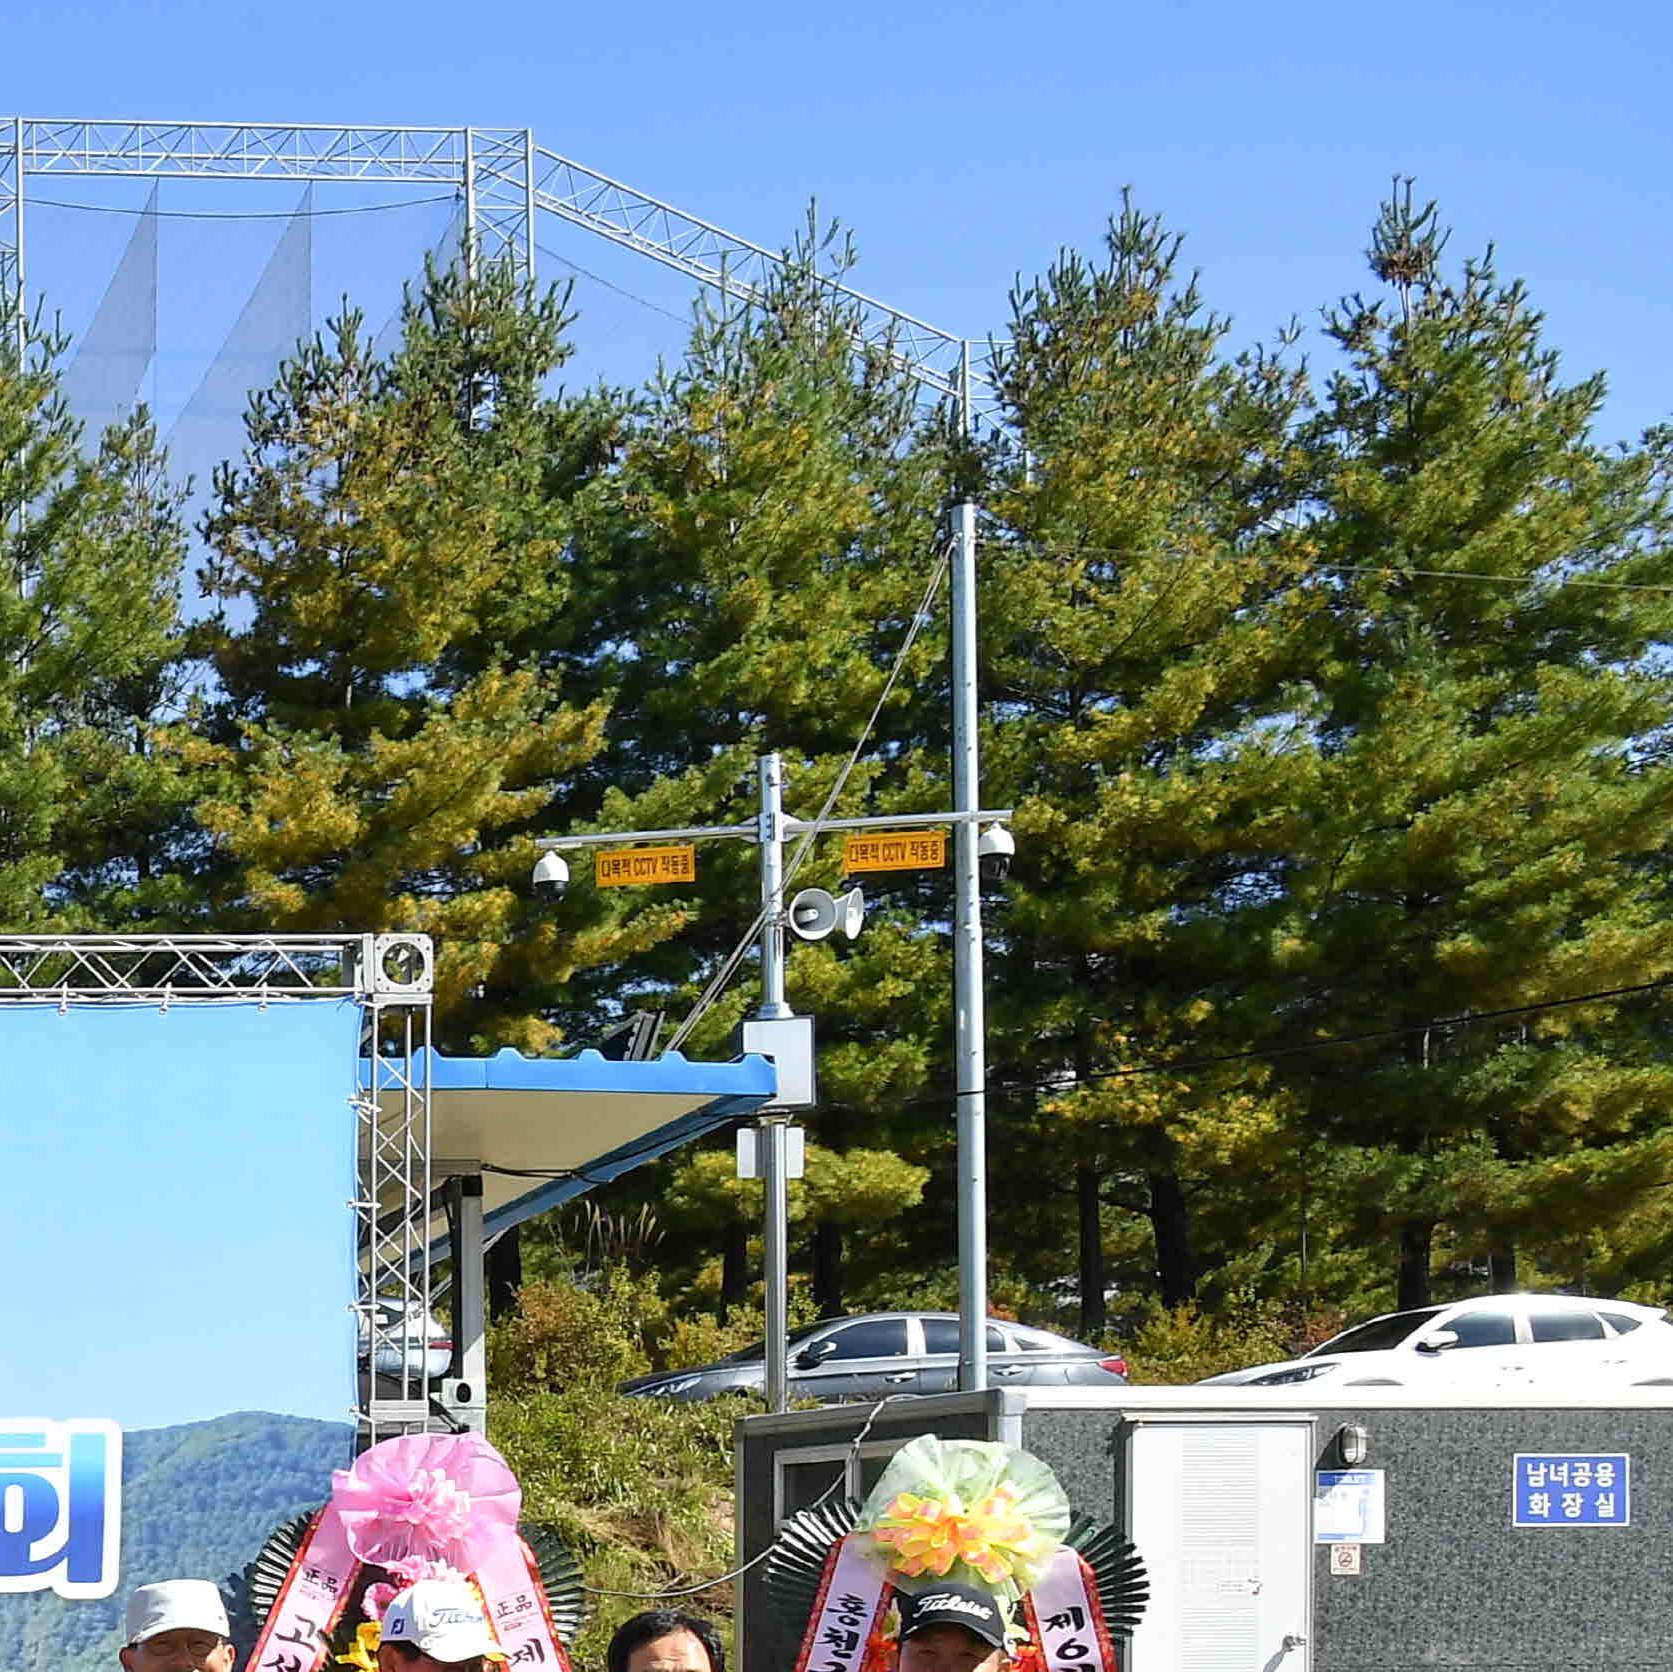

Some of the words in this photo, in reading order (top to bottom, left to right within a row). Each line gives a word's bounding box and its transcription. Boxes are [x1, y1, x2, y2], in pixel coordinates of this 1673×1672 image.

[882, 841, 907, 862] CCTV
[633, 857, 658, 876] CCTV
[1526, 1462, 1616, 1488] 남녀공용
